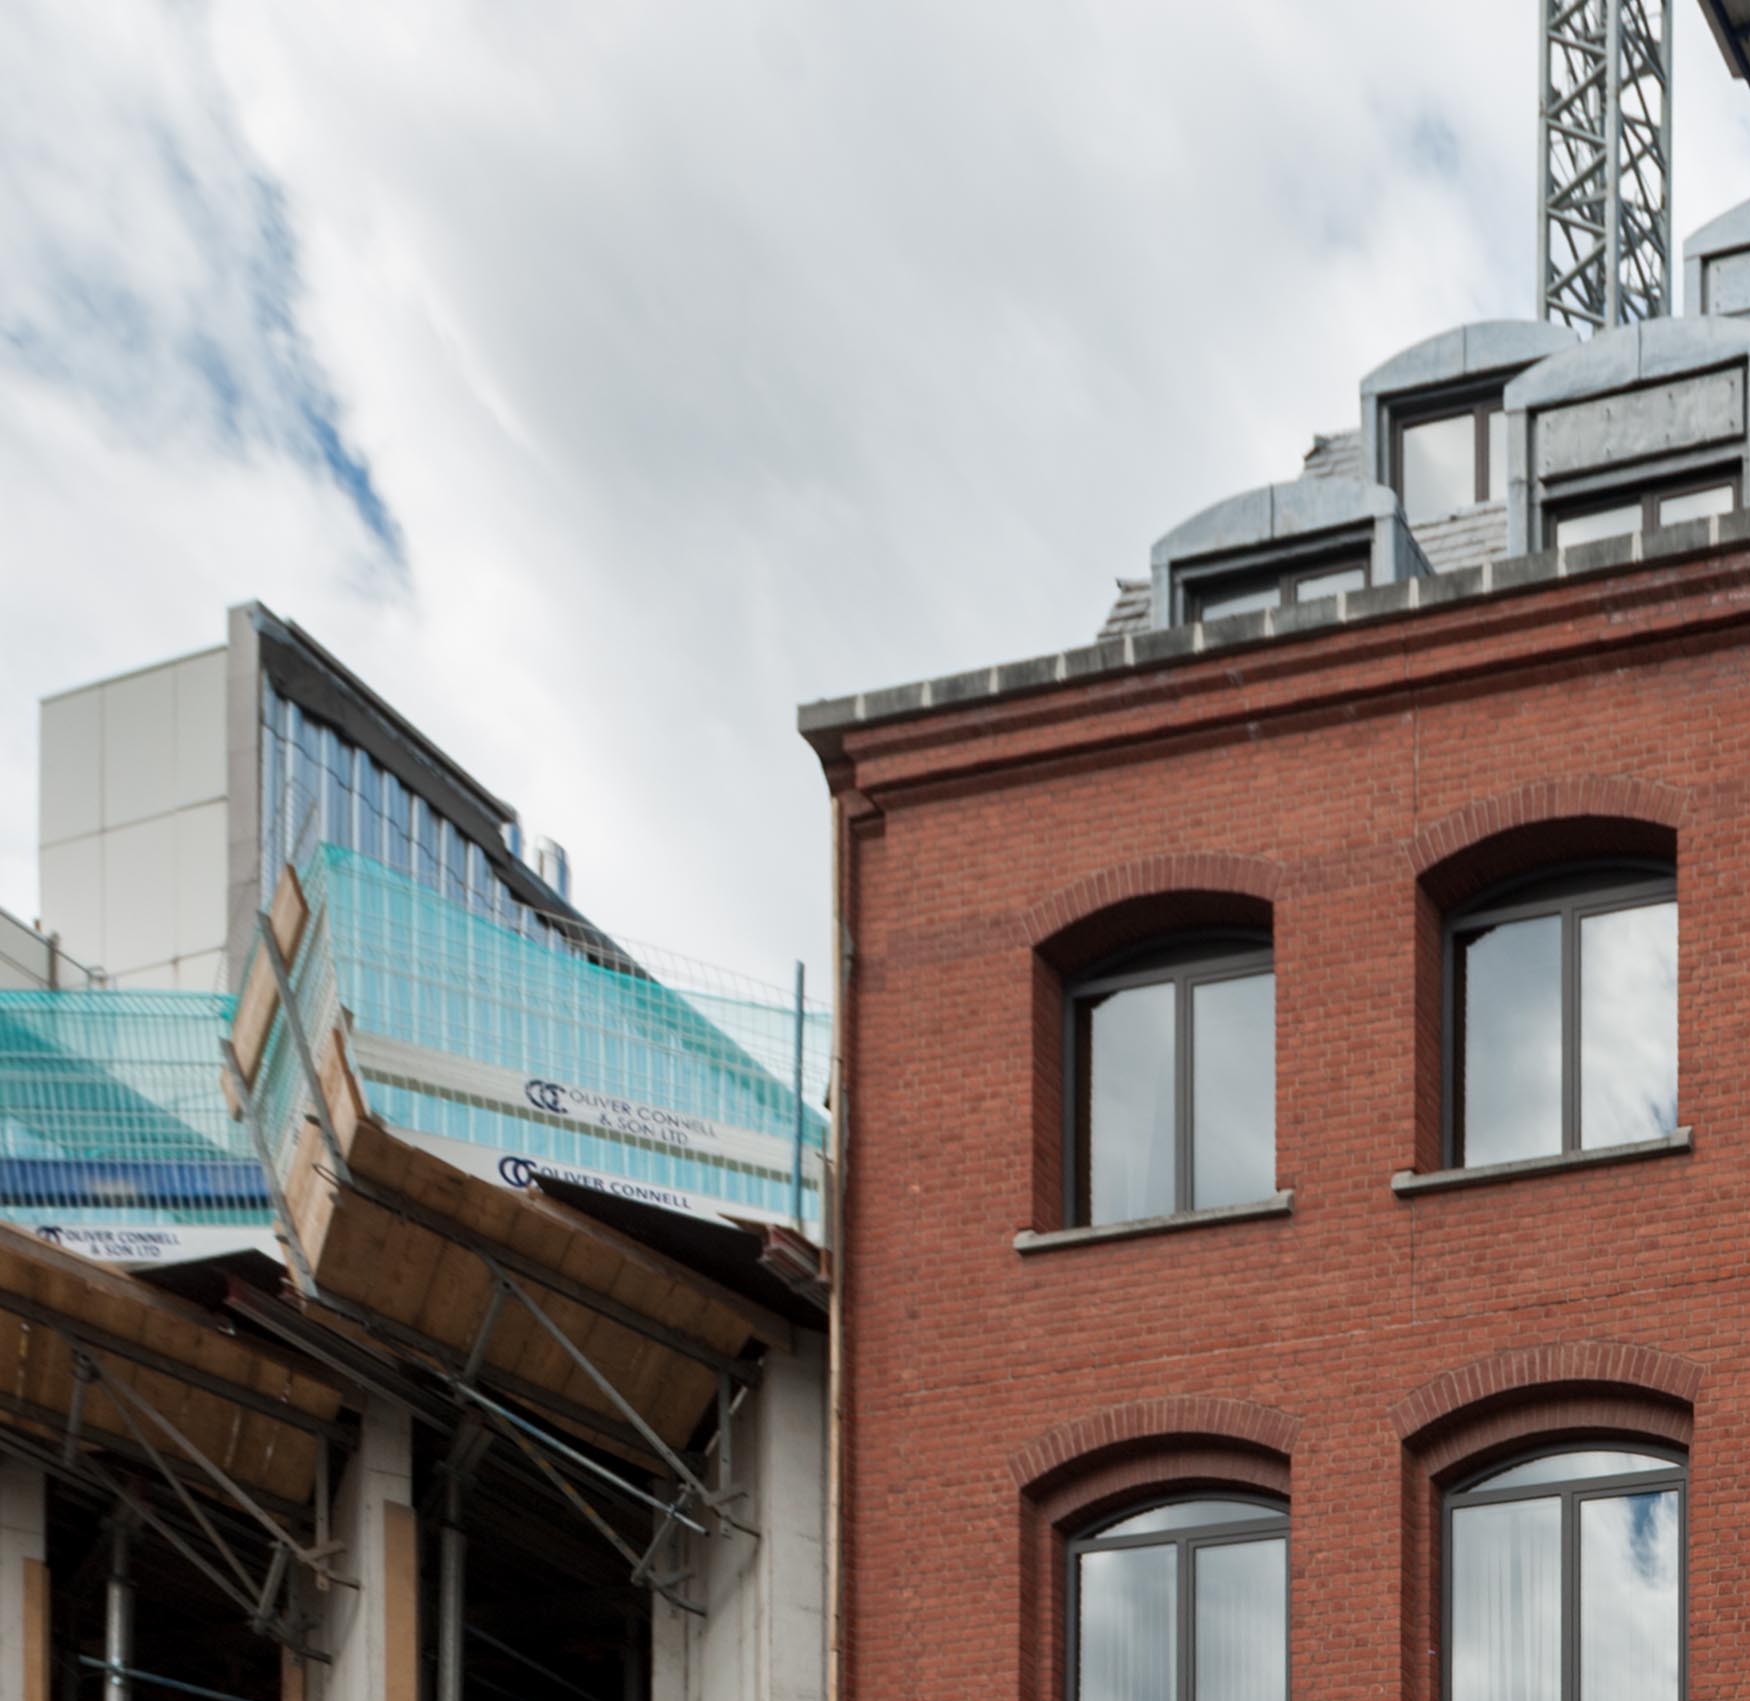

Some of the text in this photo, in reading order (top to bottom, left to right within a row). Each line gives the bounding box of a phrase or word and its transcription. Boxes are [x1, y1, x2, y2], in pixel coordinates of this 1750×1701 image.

[569, 1089, 631, 1116] OLIVER
[637, 1107, 716, 1137] CONNELL
[599, 1113, 688, 1145] & SON LTD
[540, 1166, 604, 1190] OLIVER
[610, 1180, 692, 1208] CONNELL
[118, 1231, 180, 1245] CONNELL
